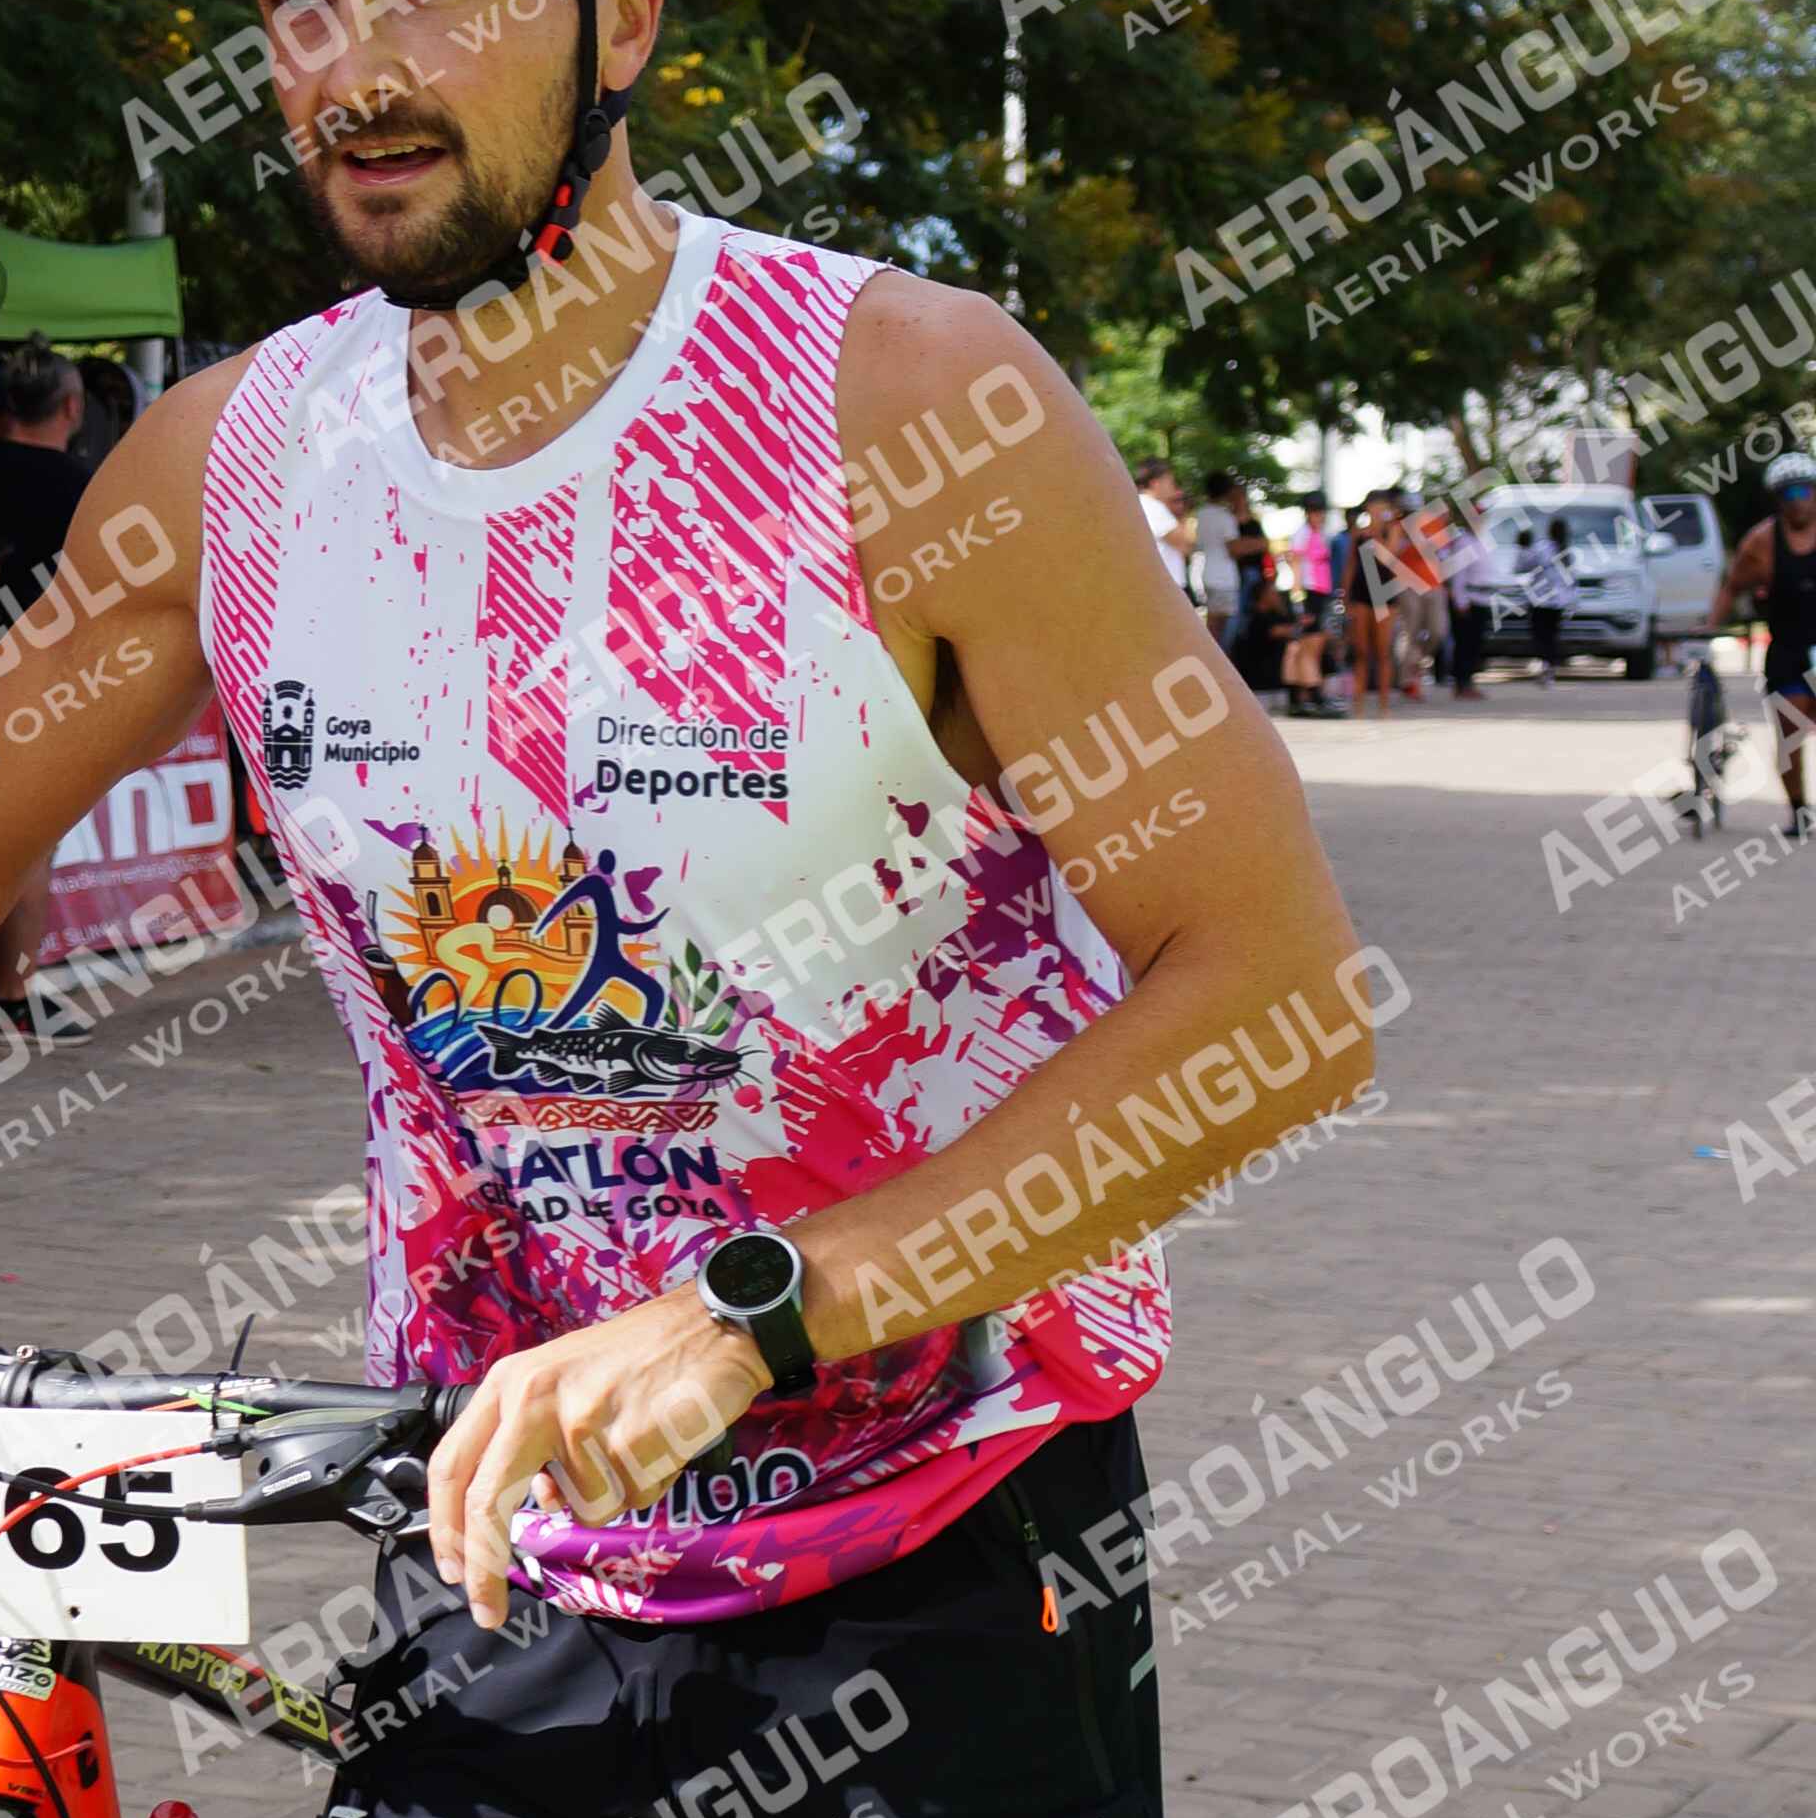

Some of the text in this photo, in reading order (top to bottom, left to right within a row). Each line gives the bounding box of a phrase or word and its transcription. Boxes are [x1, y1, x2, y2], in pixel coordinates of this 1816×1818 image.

[326, 716, 372, 738] Goya
[597, 717, 789, 750] Dirección de
[325, 742, 420, 764] Municipio
[596, 758, 790, 801] Deportes
[625, 1193, 728, 1224] GOYA
[4, 1466, 180, 1573] 65
